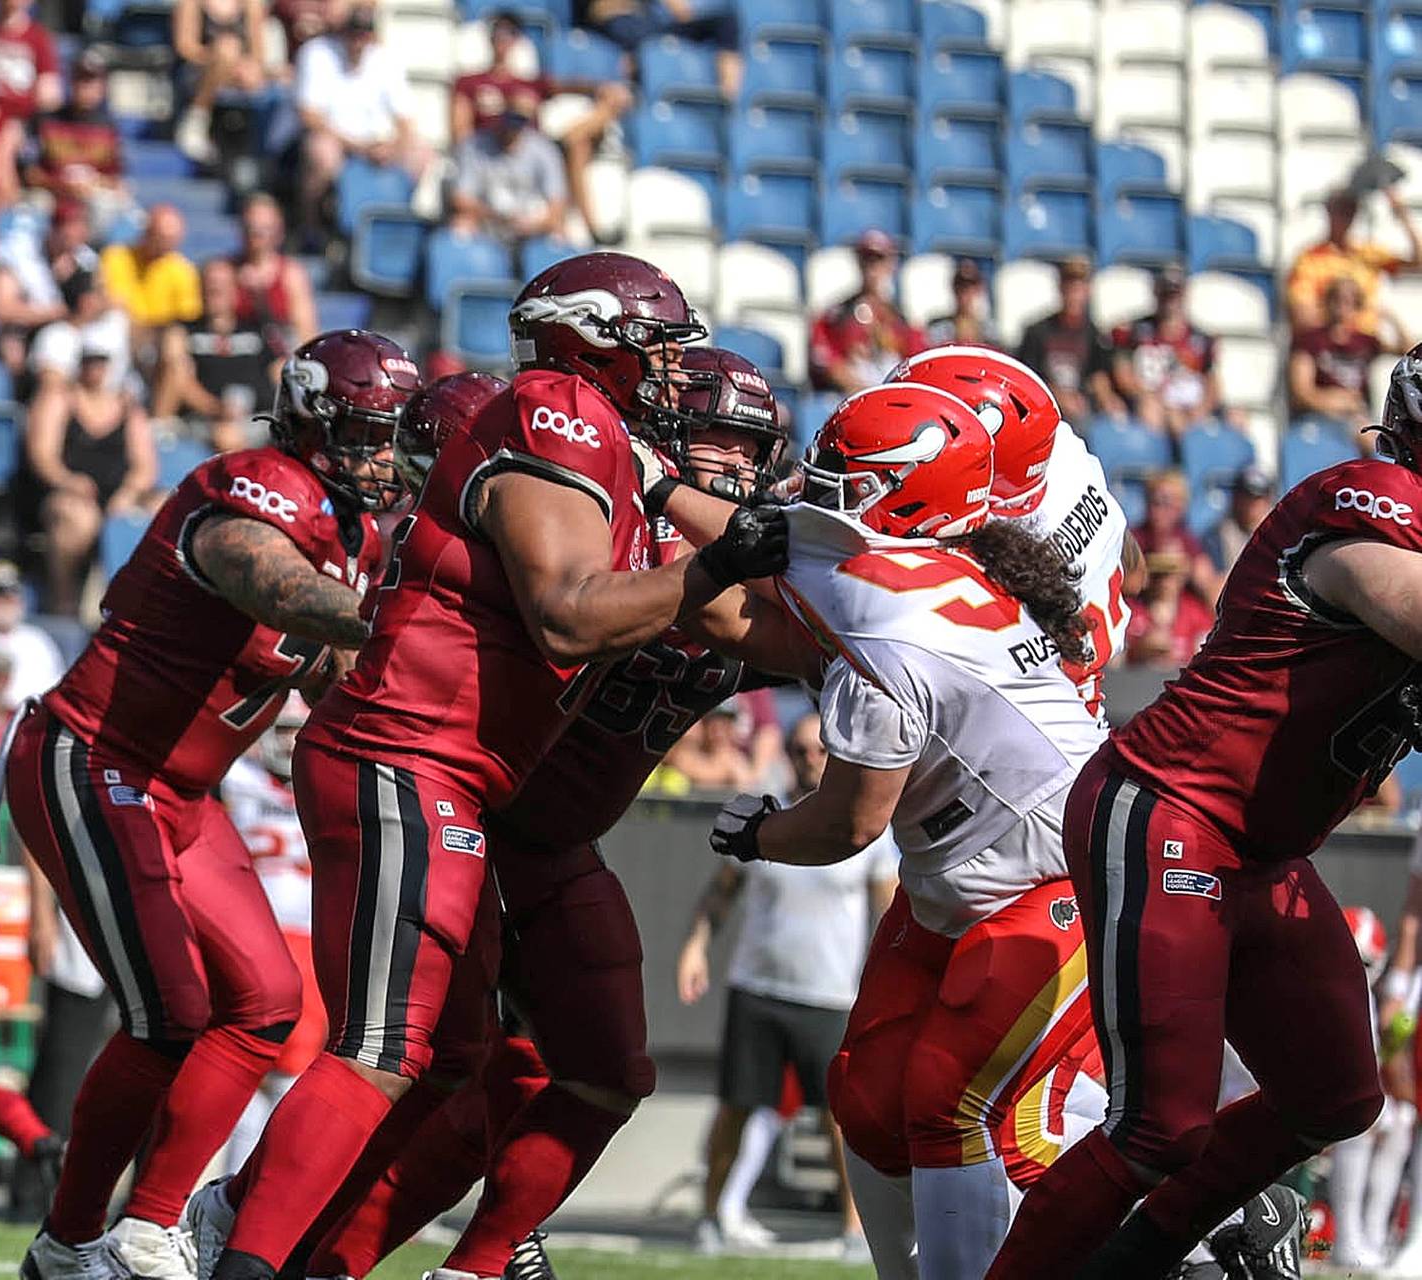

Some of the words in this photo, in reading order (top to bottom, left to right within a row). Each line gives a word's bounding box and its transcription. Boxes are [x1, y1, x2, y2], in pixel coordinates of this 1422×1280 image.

[531, 406, 602, 449] pape
[230, 476, 299, 523] pape
[1335, 487, 1414, 526] pape
